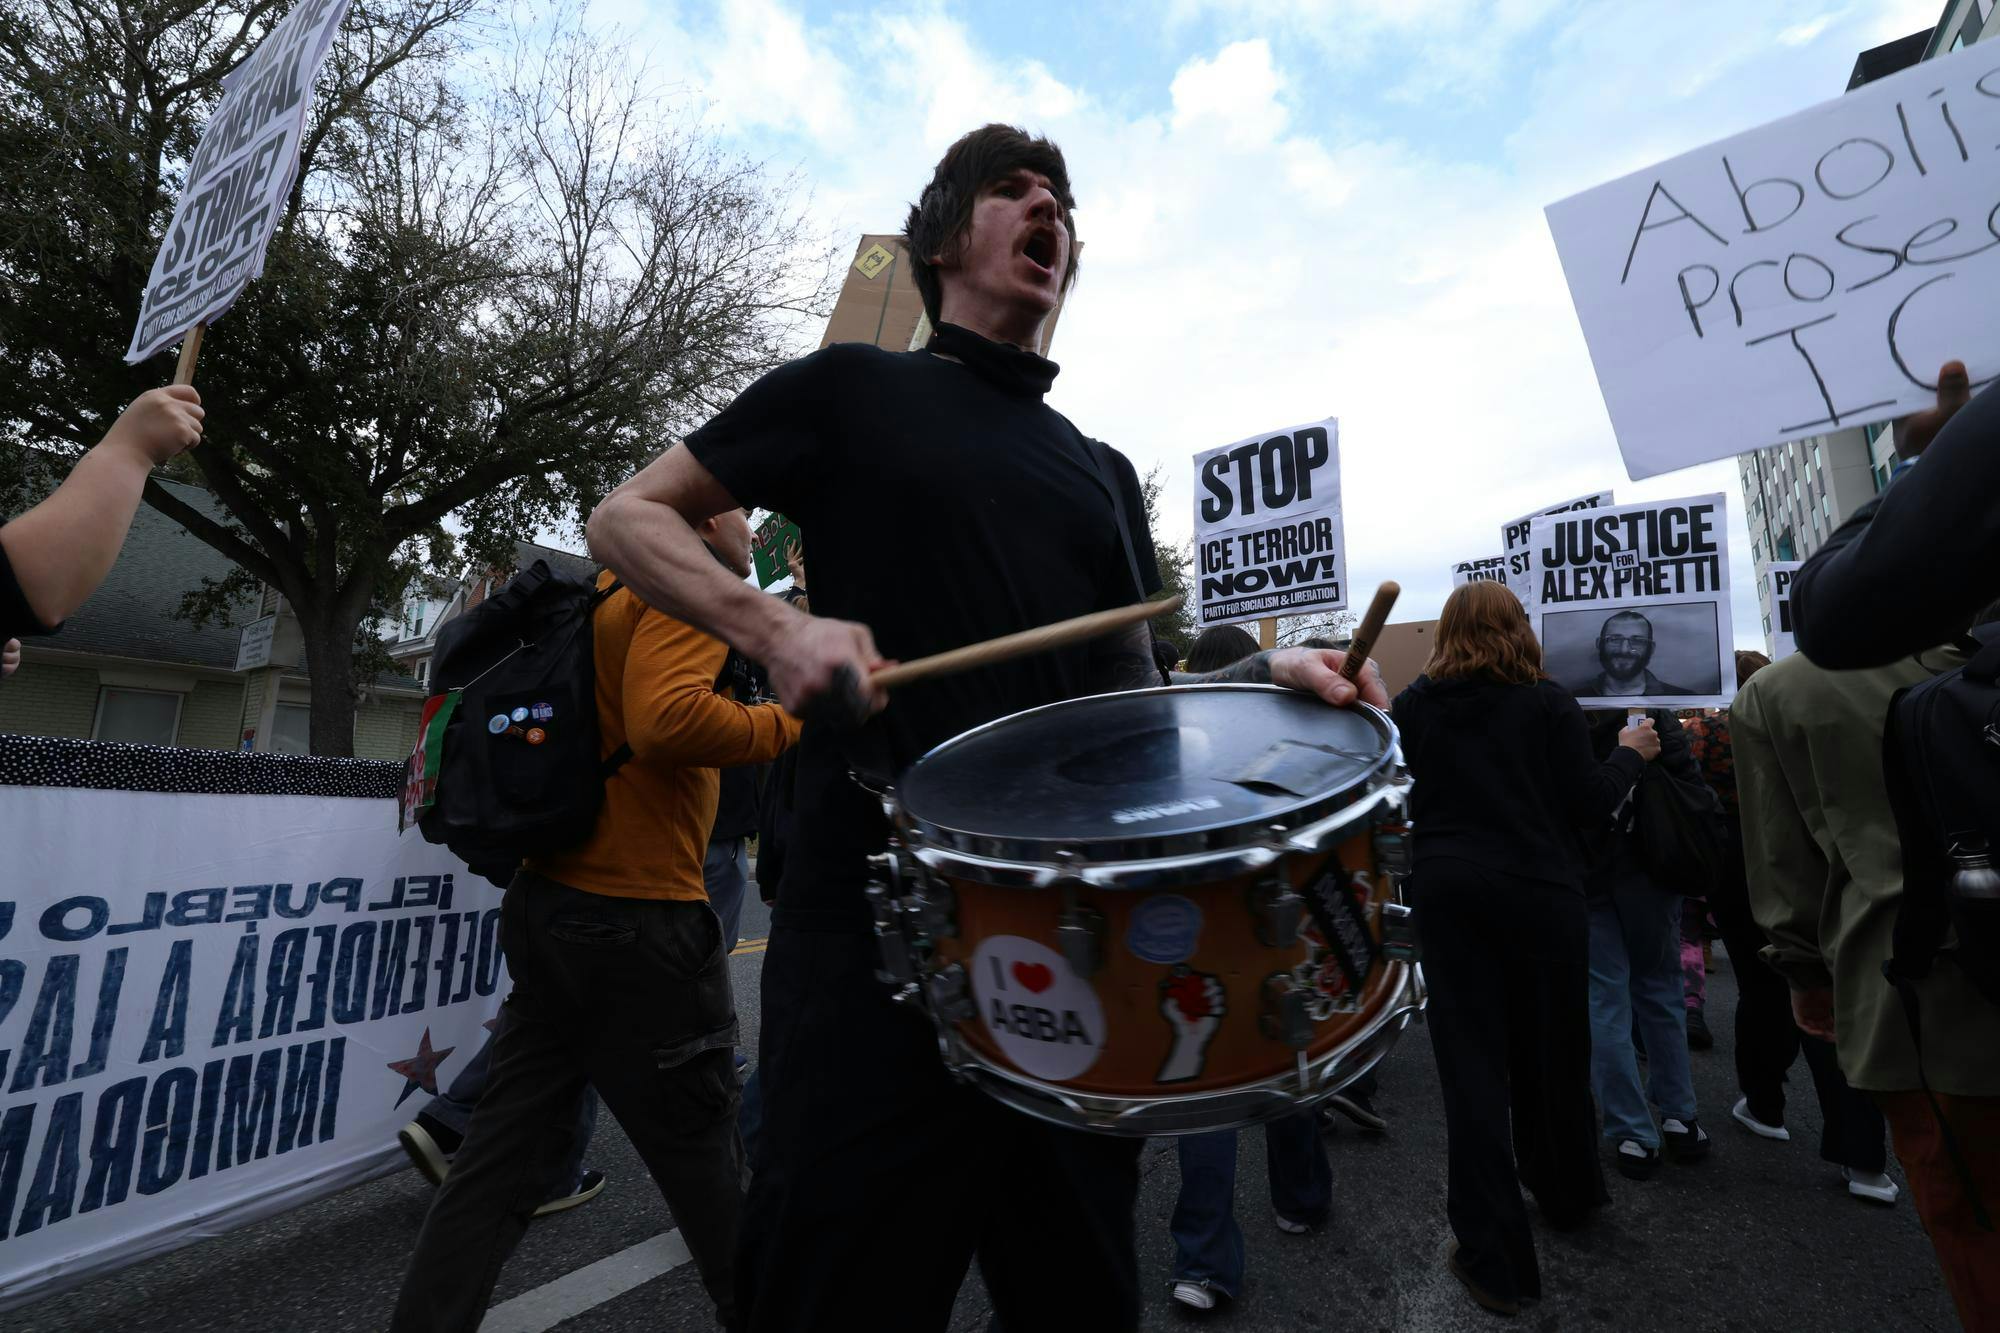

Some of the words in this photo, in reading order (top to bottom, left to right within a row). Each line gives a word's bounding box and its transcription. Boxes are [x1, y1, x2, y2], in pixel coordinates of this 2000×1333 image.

[186, 36, 308, 196] GENERAL
[162, 130, 288, 275] STRIKE!
[145, 264, 196, 314] ICE
[197, 202, 271, 281] OUT!
[1201, 427, 1329, 524] STOP
[1201, 537, 1234, 576] ICE
[1238, 517, 1334, 567] TERROR
[1542, 505, 1717, 568] JUSTICE
[1615, 554, 1635, 567] FOR
[1202, 554, 1335, 601] NOW!
[1204, 606, 1227, 619] PARTY
[1226, 603, 1240, 615] FOR
[1240, 595, 1279, 612] SOCIALISM
[1280, 594, 1290, 606] &
[1290, 586, 1336, 604] LIBERATION
[1541, 565, 1610, 605] ALEX
[1613, 555, 1720, 598] PRETTI
[988, 955, 1008, 991] I
[990, 998, 1095, 1046] ABBA
